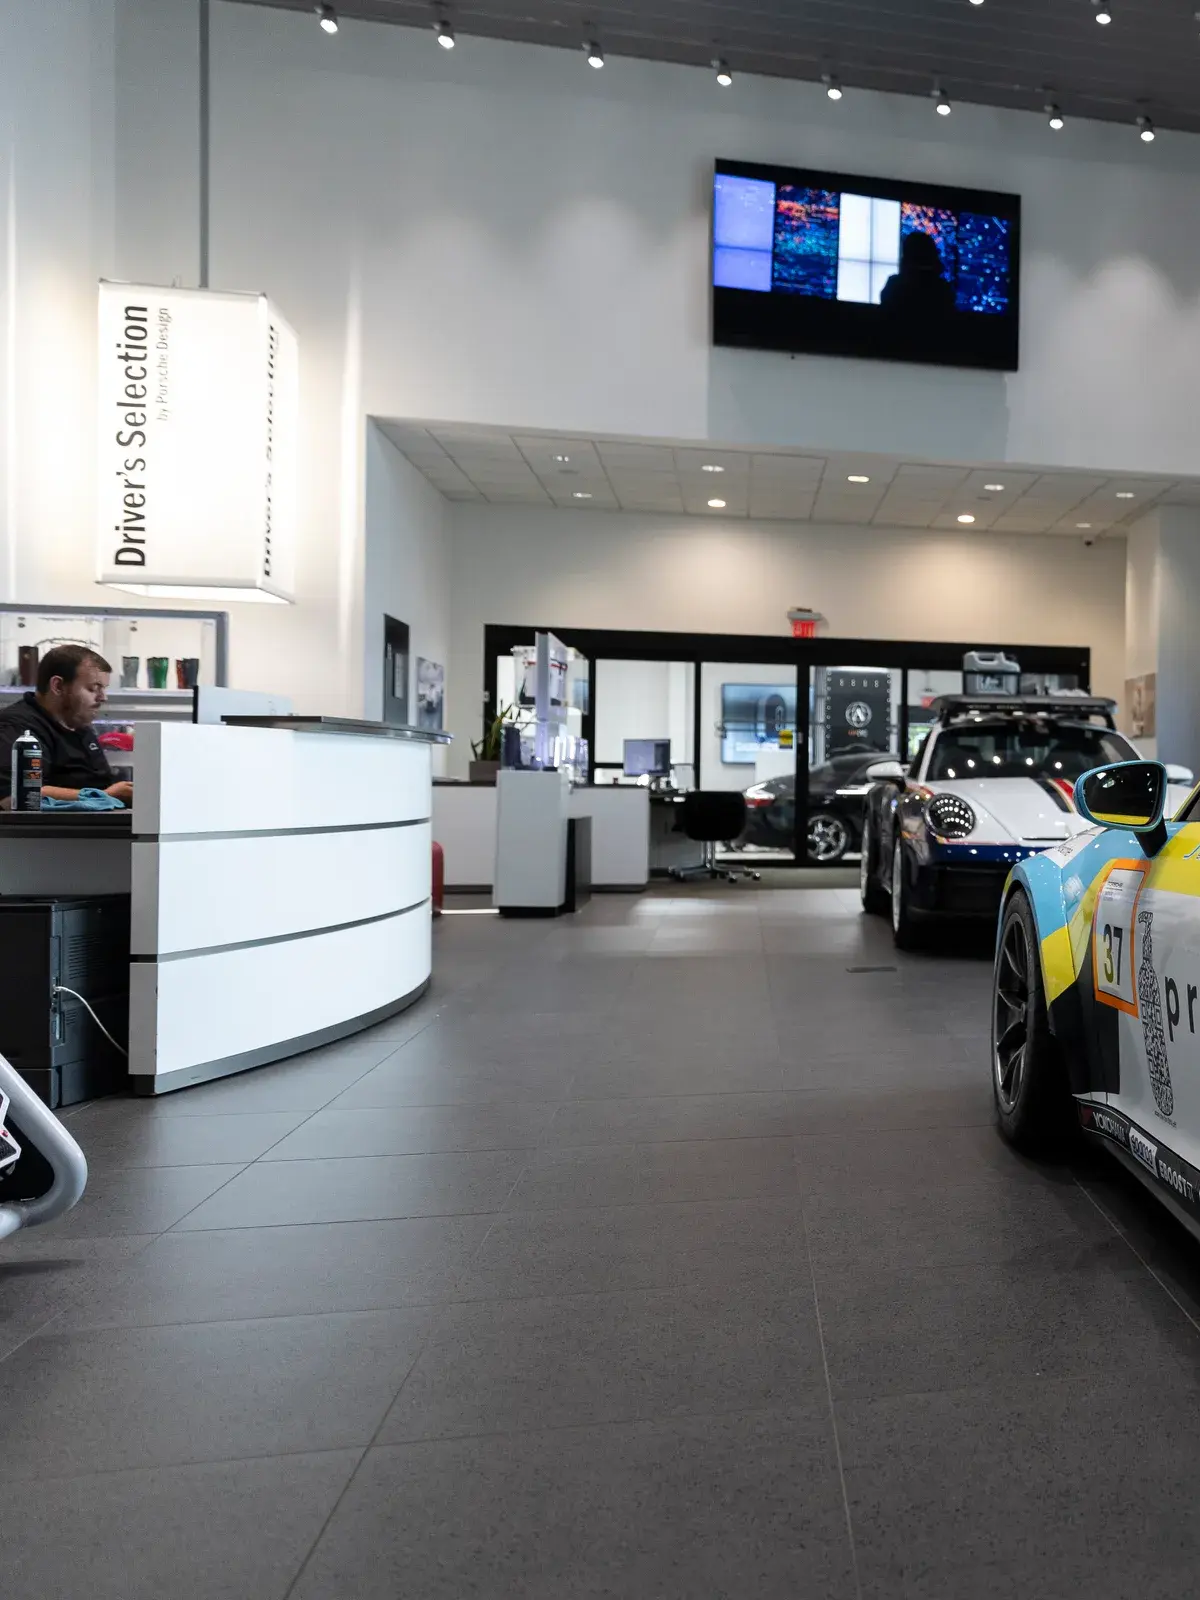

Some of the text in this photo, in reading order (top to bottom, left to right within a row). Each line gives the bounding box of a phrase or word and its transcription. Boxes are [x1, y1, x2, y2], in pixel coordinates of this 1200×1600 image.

[155, 307, 173, 422] by Porsche Design
[114, 304, 149, 567] Driver's Selection
[1103, 923, 1123, 986] 37
[1092, 1111, 1126, 1144] YOKOHAMA
[1158, 1159, 1187, 1198] EBOOST
